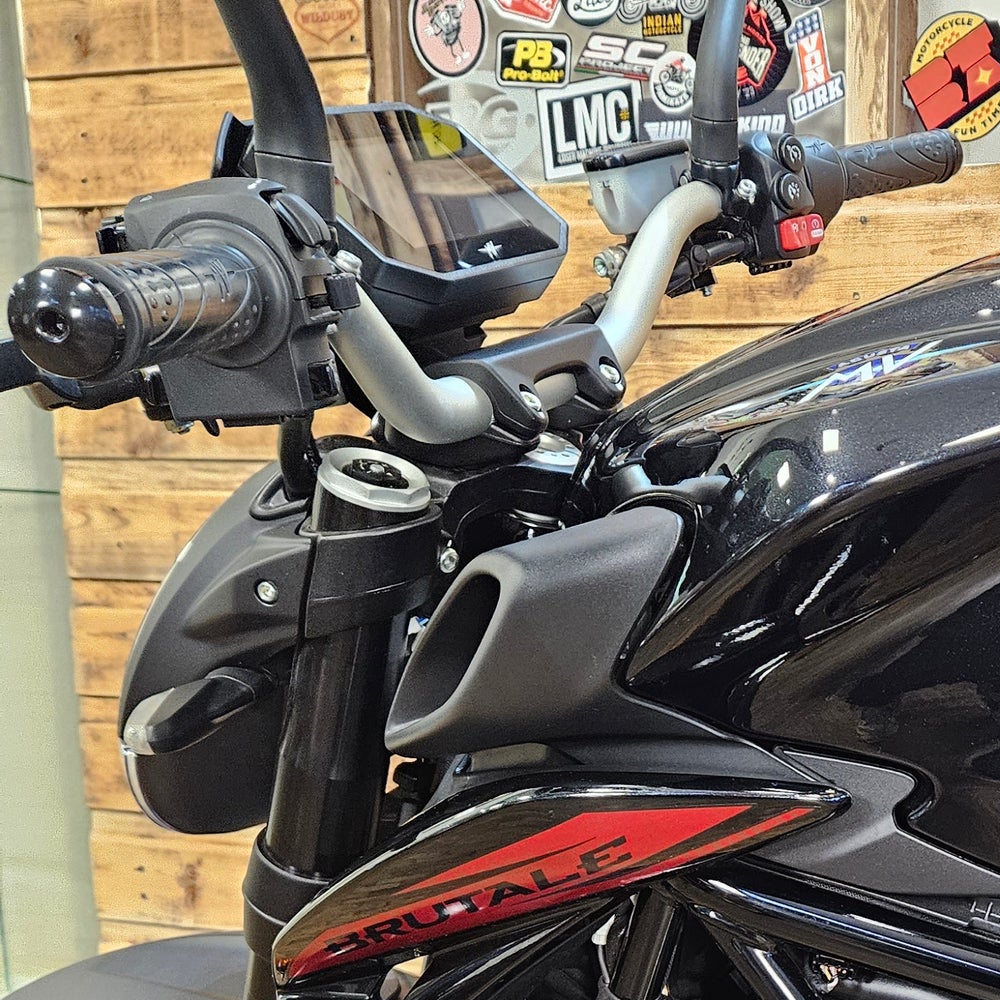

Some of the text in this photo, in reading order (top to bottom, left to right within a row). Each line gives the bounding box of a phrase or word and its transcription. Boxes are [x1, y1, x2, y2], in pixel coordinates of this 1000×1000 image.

[643, 13, 682, 28] INDIAN
[643, 24, 682, 36] MOTORCYCLE
[512, 39, 553, 68] PB
[583, 35, 667, 64] SC
[916, 17, 974, 63] MOTORCYCLE
[578, 57, 652, 74] PROJECT
[799, 33, 826, 88] VON
[793, 77, 844, 120] DIRK
[552, 89, 632, 153] LMC
[953, 126, 978, 136] FUN
[323, 836, 632, 954] BRUTALE
